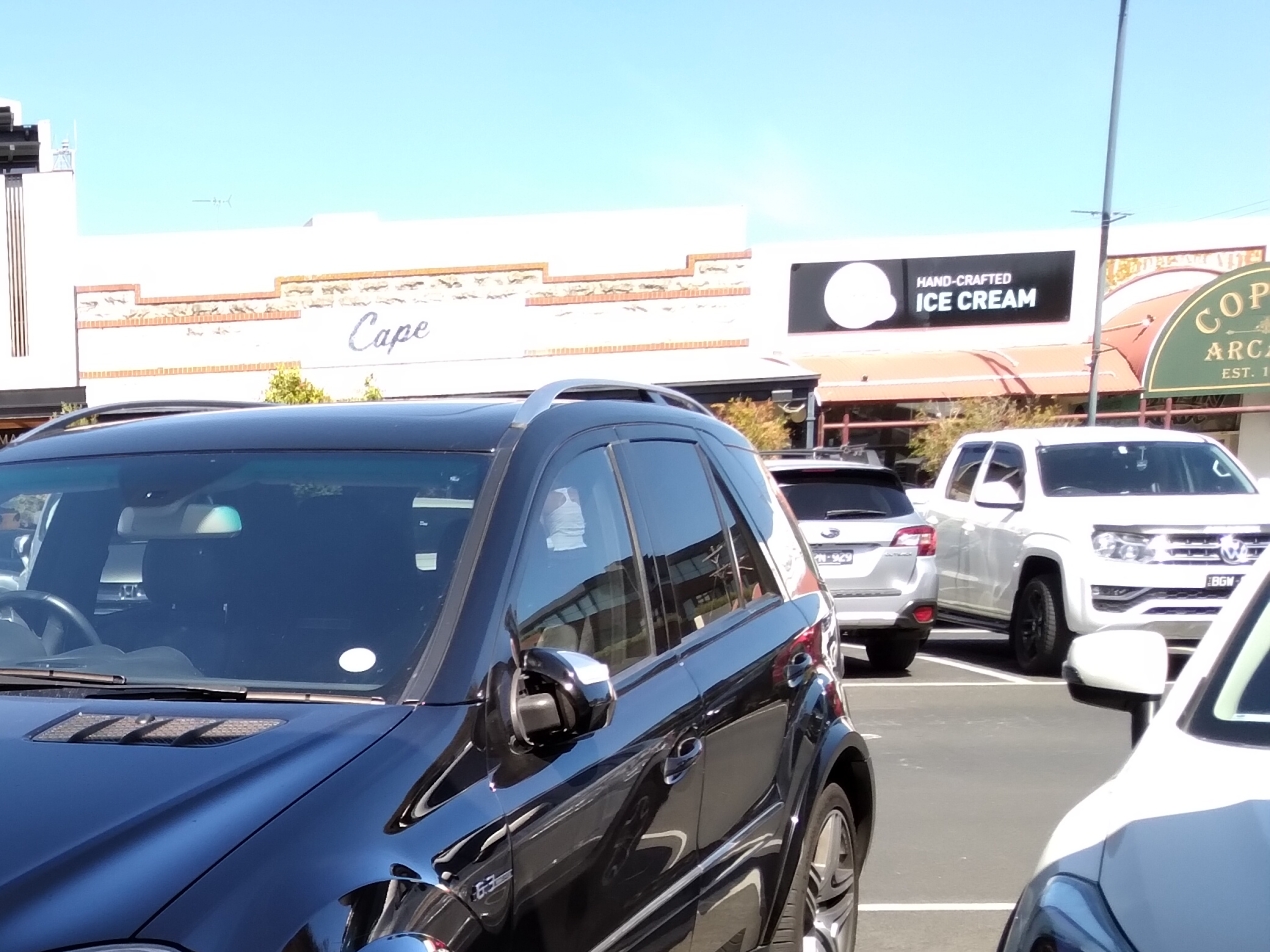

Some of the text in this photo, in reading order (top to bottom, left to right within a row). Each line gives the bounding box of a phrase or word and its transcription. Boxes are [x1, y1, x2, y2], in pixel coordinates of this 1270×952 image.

[916, 273, 1012, 288] HAND-CRAFTED
[916, 288, 1037, 312] ICE CREAM
[348, 311, 430, 355] Cape
[1222, 367, 1255, 379] EST.
